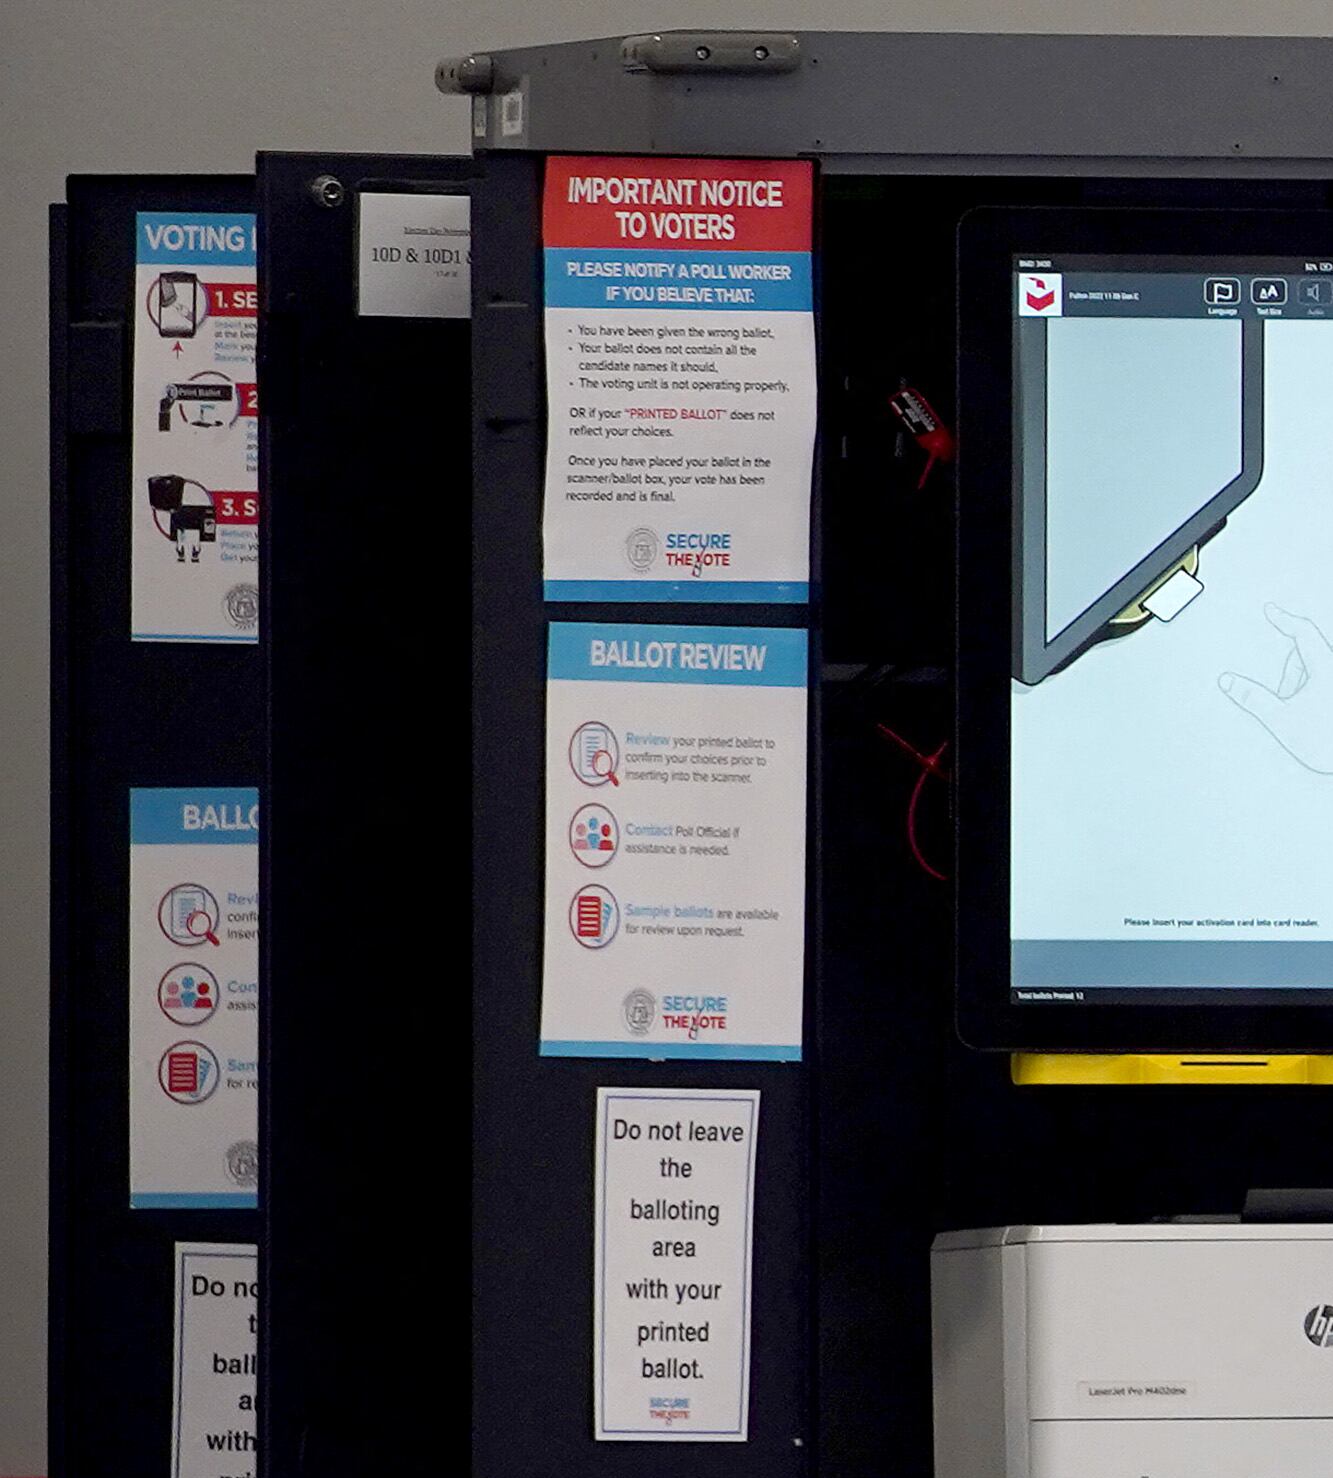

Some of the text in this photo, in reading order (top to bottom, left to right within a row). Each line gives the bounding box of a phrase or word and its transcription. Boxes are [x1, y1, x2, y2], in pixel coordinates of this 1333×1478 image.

[568, 177, 782, 206] IMPORTANT NOTICE
[615, 211, 734, 239] TO VOTERS
[145, 223, 245, 252] VOTING
[371, 247, 461, 264] 10D & 10D1
[566, 262, 791, 279] PLEASE NOTIFY A POLL WORKER
[215, 291, 228, 308] 1.
[606, 286, 754, 302] IF YOU BELIEVE THAT:
[578, 324, 596, 335] You
[599, 325, 624, 336] have
[627, 326, 653, 336] been
[656, 326, 685, 339] given
[688, 327, 704, 337] the
[707, 329, 739, 340] wrong
[578, 342, 756, 355] Your ballot does not contain all the
[578, 360, 630, 370] candidate
[633, 363, 667, 372] names
[671, 361, 677, 371] it
[578, 377, 598, 388] The
[601, 378, 634, 391] voting
[637, 379, 657, 389] unit
[660, 381, 668, 390] is
[672, 380, 689, 390] not
[692, 381, 740, 392] operating
[569, 407, 585, 417] OR
[588, 407, 595, 417] if
[598, 410, 621, 420] your
[730, 411, 754, 421] does
[758, 411, 774, 421] not
[569, 425, 602, 436] reflect
[605, 428, 628, 438] your
[666, 534, 730, 549] SECURE
[665, 553, 693, 566] THE
[590, 640, 766, 670] BALLOT REVIEW
[664, 996, 726, 1012] SECURE
[663, 1015, 689, 1029] THE
[614, 1118, 743, 1141] Do not leave
[660, 1157, 691, 1177] the
[630, 1199, 719, 1225] balloting
[652, 1241, 695, 1257] area
[192, 1275, 225, 1296] Do
[626, 1278, 721, 1304] with your
[638, 1321, 708, 1345] printed
[642, 1358, 703, 1378] ballot.
